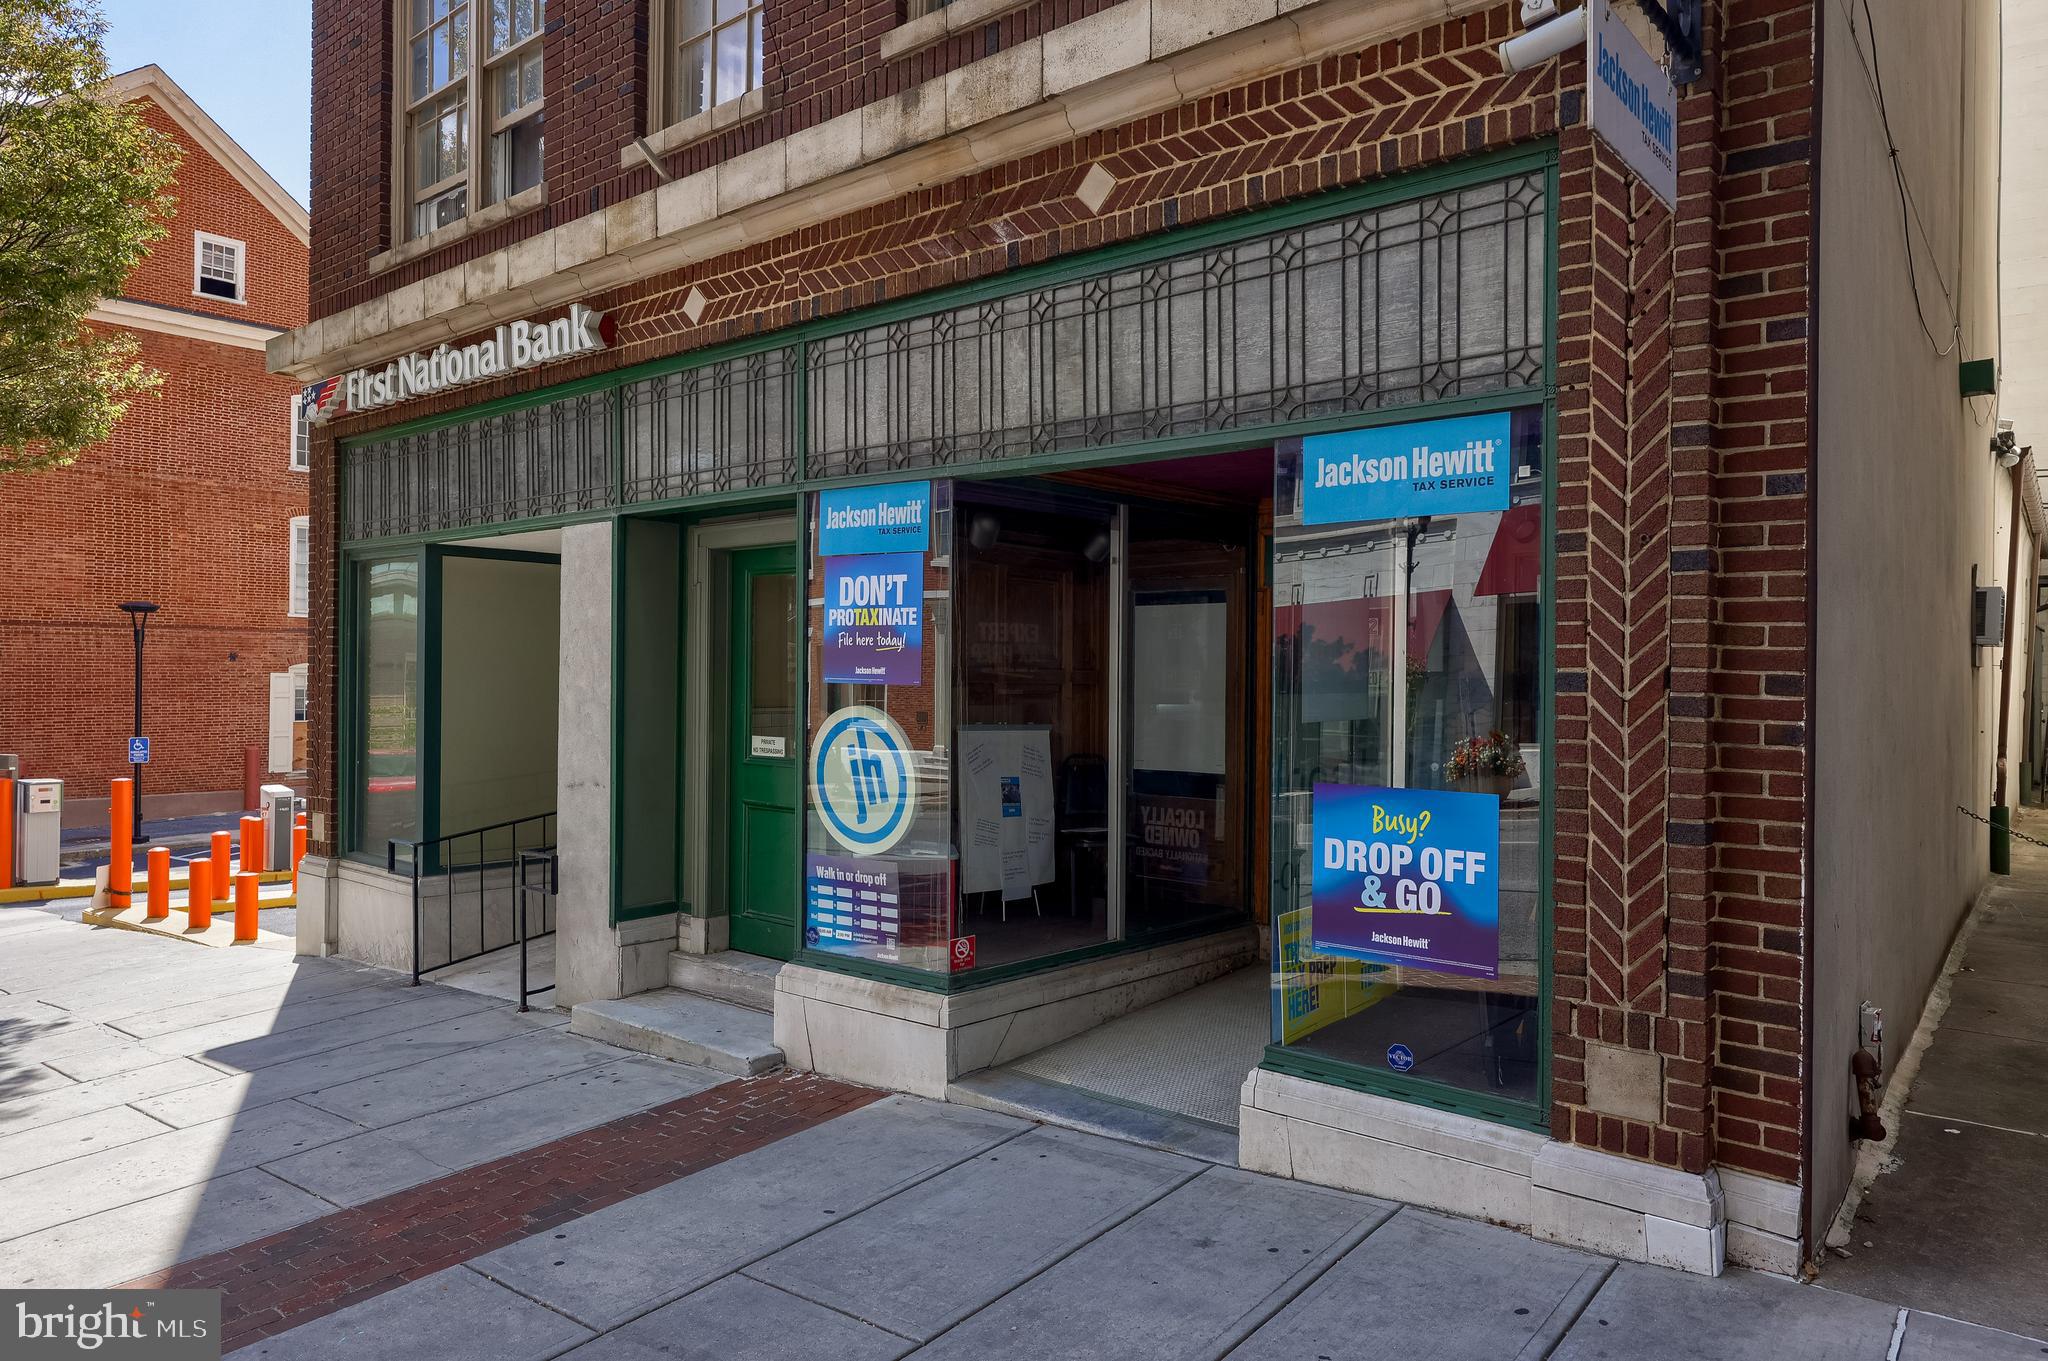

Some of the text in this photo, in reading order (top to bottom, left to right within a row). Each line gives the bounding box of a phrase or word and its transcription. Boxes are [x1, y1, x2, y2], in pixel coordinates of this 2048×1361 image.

[1597, 31, 1672, 155] Jackson Hewitt
[1641, 130, 1672, 172] TAX SERVICE
[346, 303, 597, 412] First National Bank
[1314, 439, 1495, 488] Jackson Hewitt
[1412, 475, 1495, 492] TAX SERVICE
[826, 500, 922, 529] Jackson Hewitt
[878, 525, 922, 535] TAX SERVICE
[839, 574, 908, 607] DON'T
[829, 607, 917, 626] PROTAXINATE
[838, 631, 906, 652] File here today!
[1372, 805, 1431, 844] Busy?
[816, 865, 887, 887] Walk in or drop off
[1324, 837, 1487, 885] DROP OFF
[1361, 875, 1441, 915] & GO
[1371, 931, 1429, 950] Jackson Hewitt
[1288, 984, 1320, 1021] HERE!
